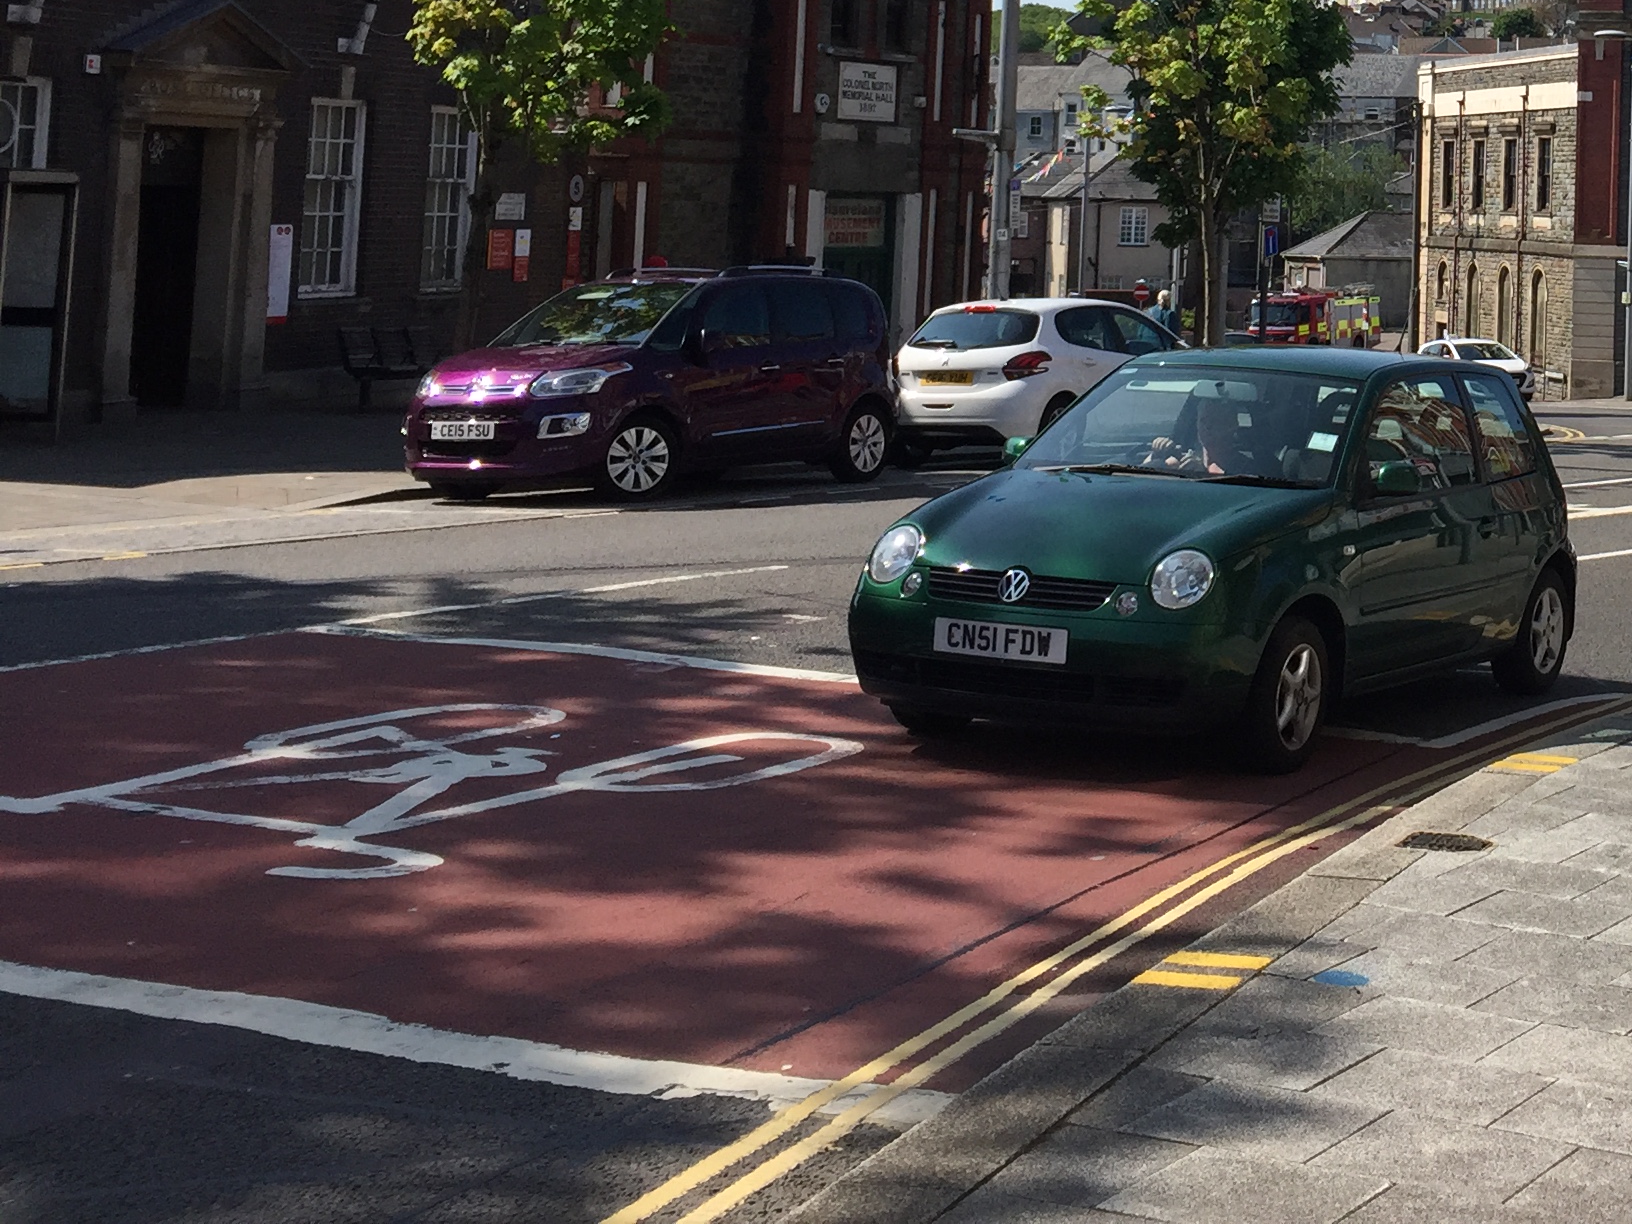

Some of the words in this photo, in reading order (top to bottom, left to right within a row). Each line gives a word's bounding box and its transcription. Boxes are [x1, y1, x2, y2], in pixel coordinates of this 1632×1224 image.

[862, 70, 877, 80] THE
[824, 217, 881, 230] MUSEMENT
[440, 424, 465, 437] CE15
[467, 424, 491, 437] FSU
[947, 622, 998, 652] CN51
[1003, 628, 1052, 657] FDW
